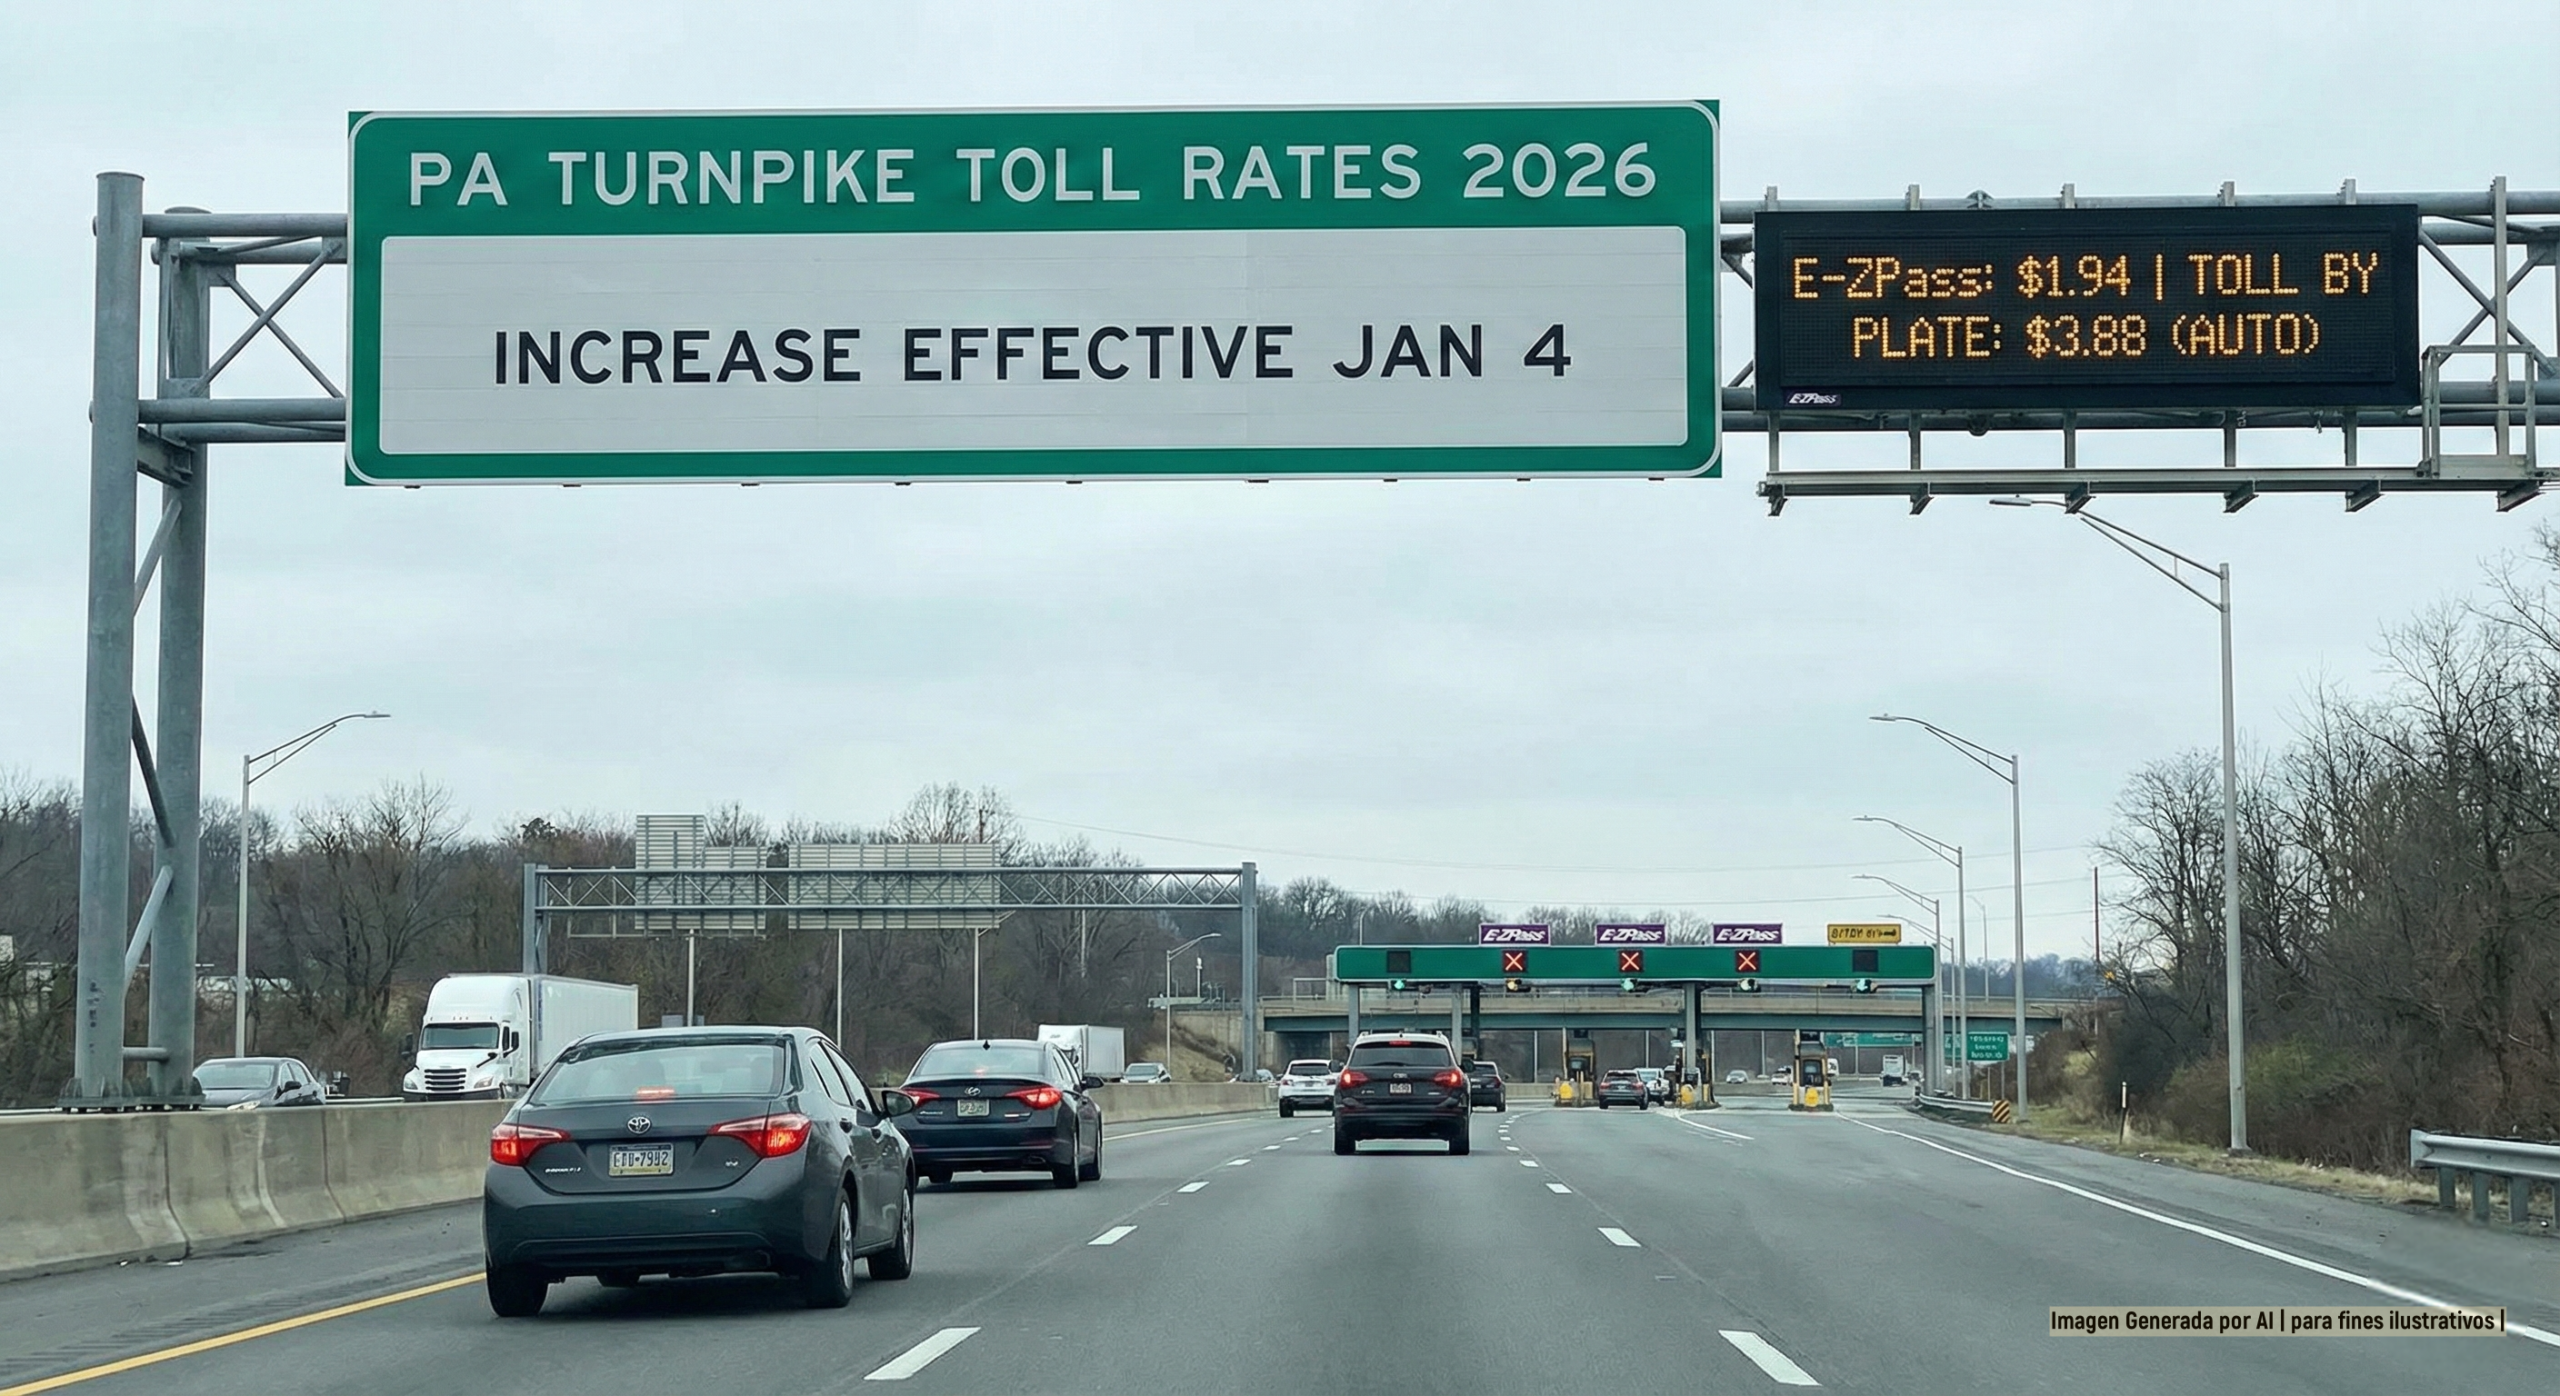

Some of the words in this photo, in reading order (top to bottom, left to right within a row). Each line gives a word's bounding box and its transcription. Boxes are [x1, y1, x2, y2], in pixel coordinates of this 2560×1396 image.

[410, 152, 508, 206] PA
[548, 149, 915, 206] TURNPIKE
[956, 147, 1140, 202] TOLL
[1184, 144, 1421, 200] RATES
[1463, 142, 1656, 198] 2026
[1793, 256, 1994, 298] E-ZPass:
[2018, 255, 2131, 299] $1.94
[2187, 254, 2300, 295] TOLL
[2324, 252, 2379, 294] BY
[496, 328, 861, 385] INCREASE
[904, 325, 1293, 382] EFFECTIVE
[1332, 324, 1482, 379] JAN
[1523, 323, 1571, 377] 4
[1853, 315, 2002, 358] PLATE:
[2026, 314, 2146, 359] $3.88
[2171, 314, 2320, 356] (AUTO)
